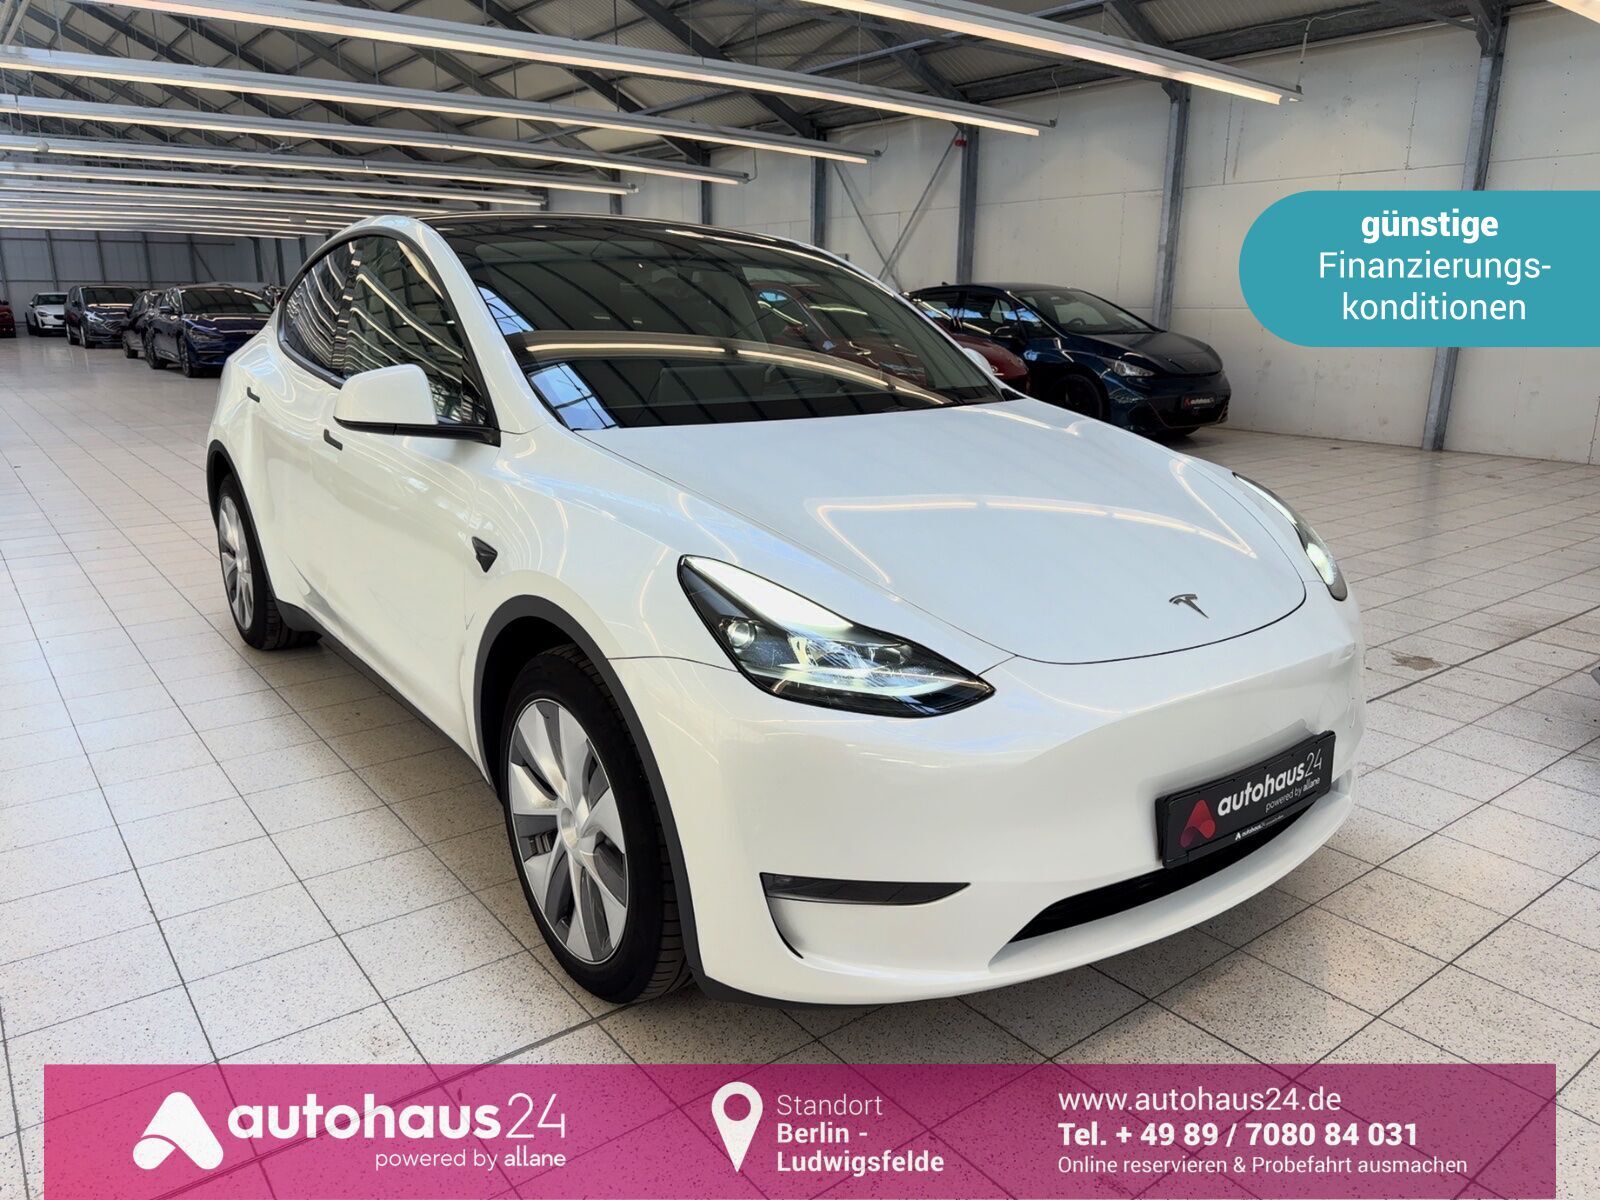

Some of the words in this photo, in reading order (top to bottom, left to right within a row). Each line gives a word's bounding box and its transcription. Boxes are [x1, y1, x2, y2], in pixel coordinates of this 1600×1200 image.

[1217, 748, 1323, 817] autohaus24
[1265, 789, 1294, 814] powered
[1294, 786, 1303, 799] by
[1302, 777, 1321, 792] allane
